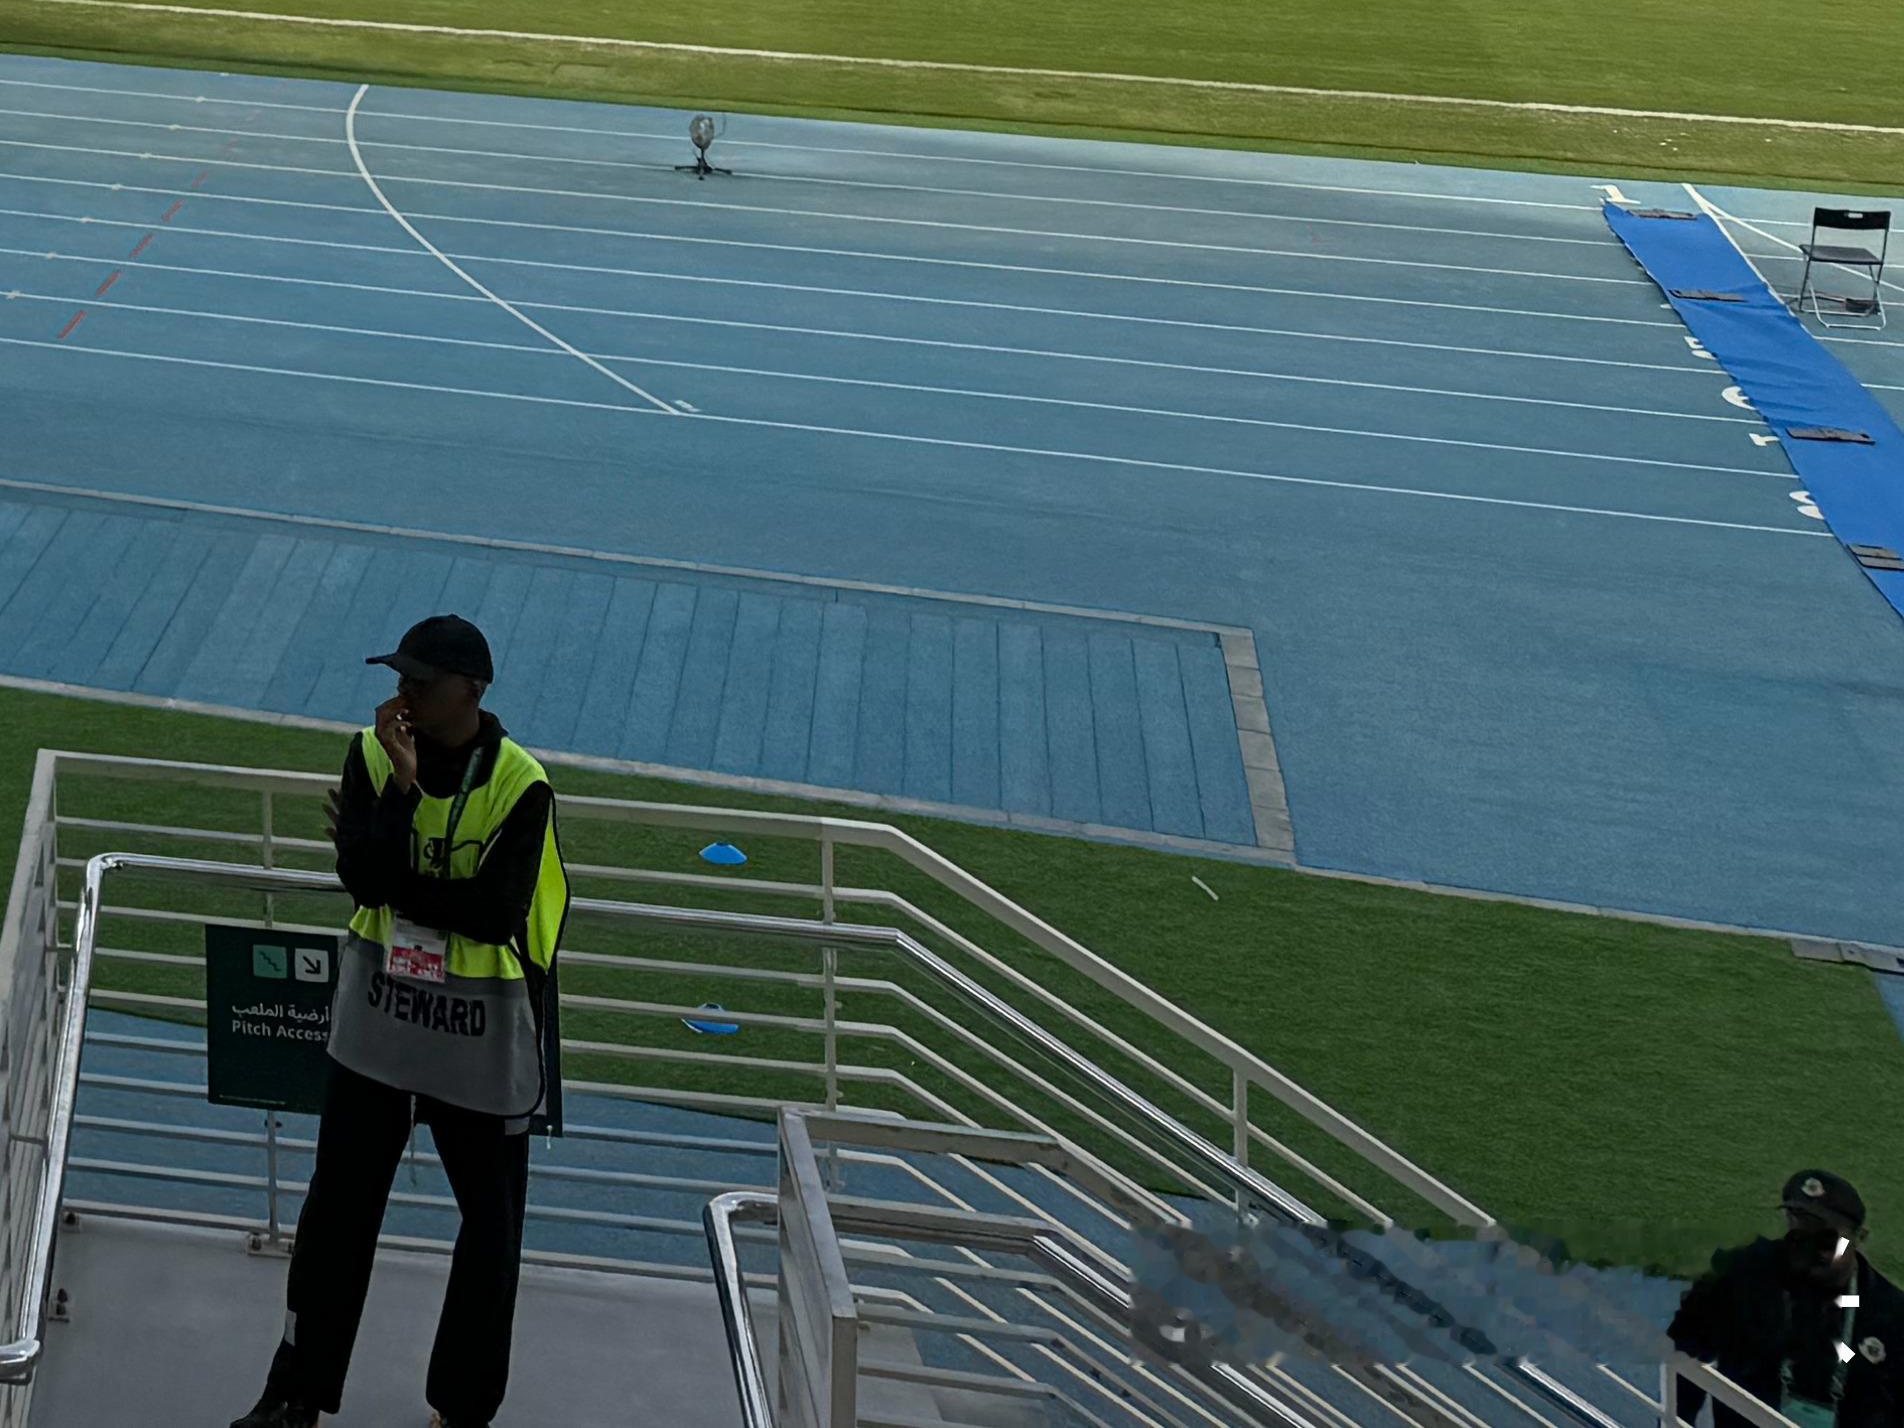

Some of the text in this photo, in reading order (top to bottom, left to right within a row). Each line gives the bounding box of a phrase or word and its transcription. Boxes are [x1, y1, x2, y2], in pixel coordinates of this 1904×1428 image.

[232, 1002, 330, 1025] أرضية الملعب
[368, 971, 487, 1037] STEWARD
[232, 1020, 329, 1043] Pitch Access
